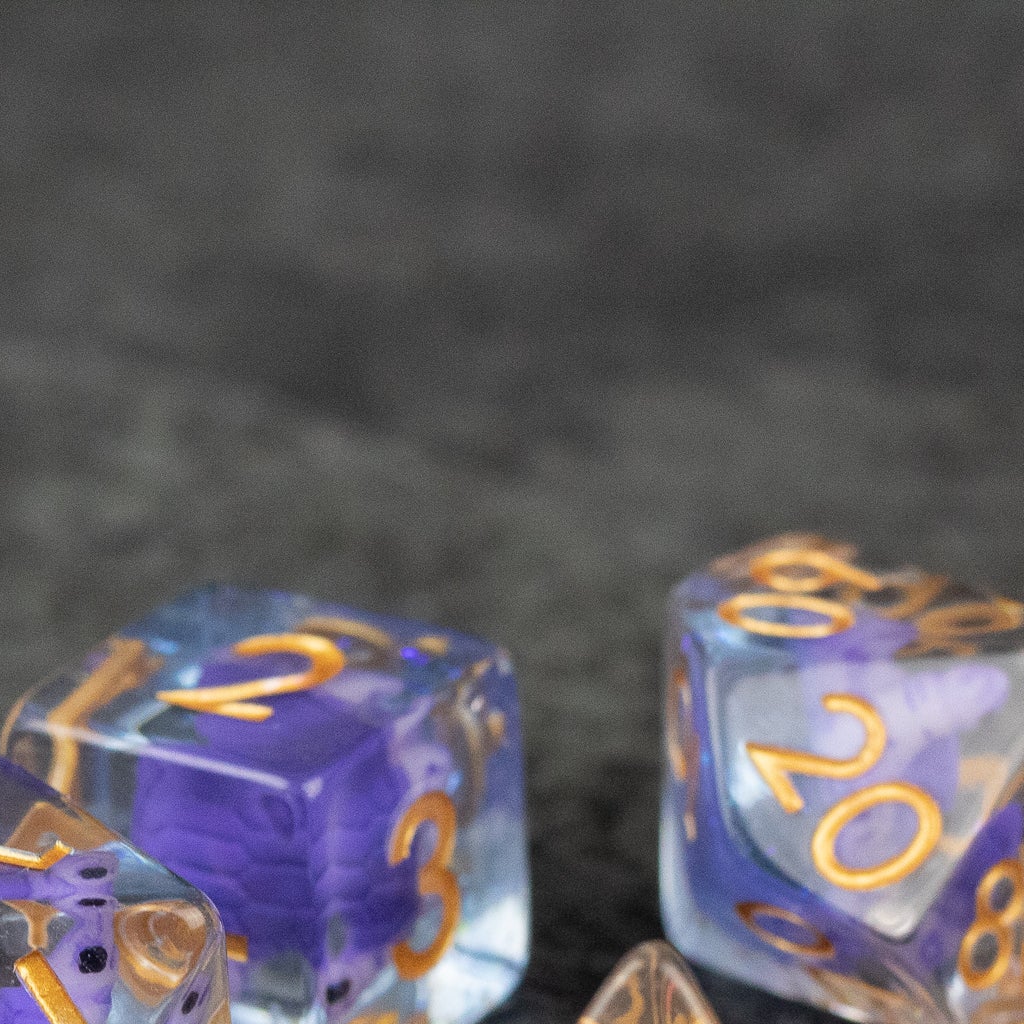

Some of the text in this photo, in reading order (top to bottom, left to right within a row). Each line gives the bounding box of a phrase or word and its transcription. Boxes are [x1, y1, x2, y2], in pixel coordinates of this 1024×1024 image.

[157, 632, 346, 721] 2
[388, 791, 462, 980] 3
[745, 693, 943, 891] 20
